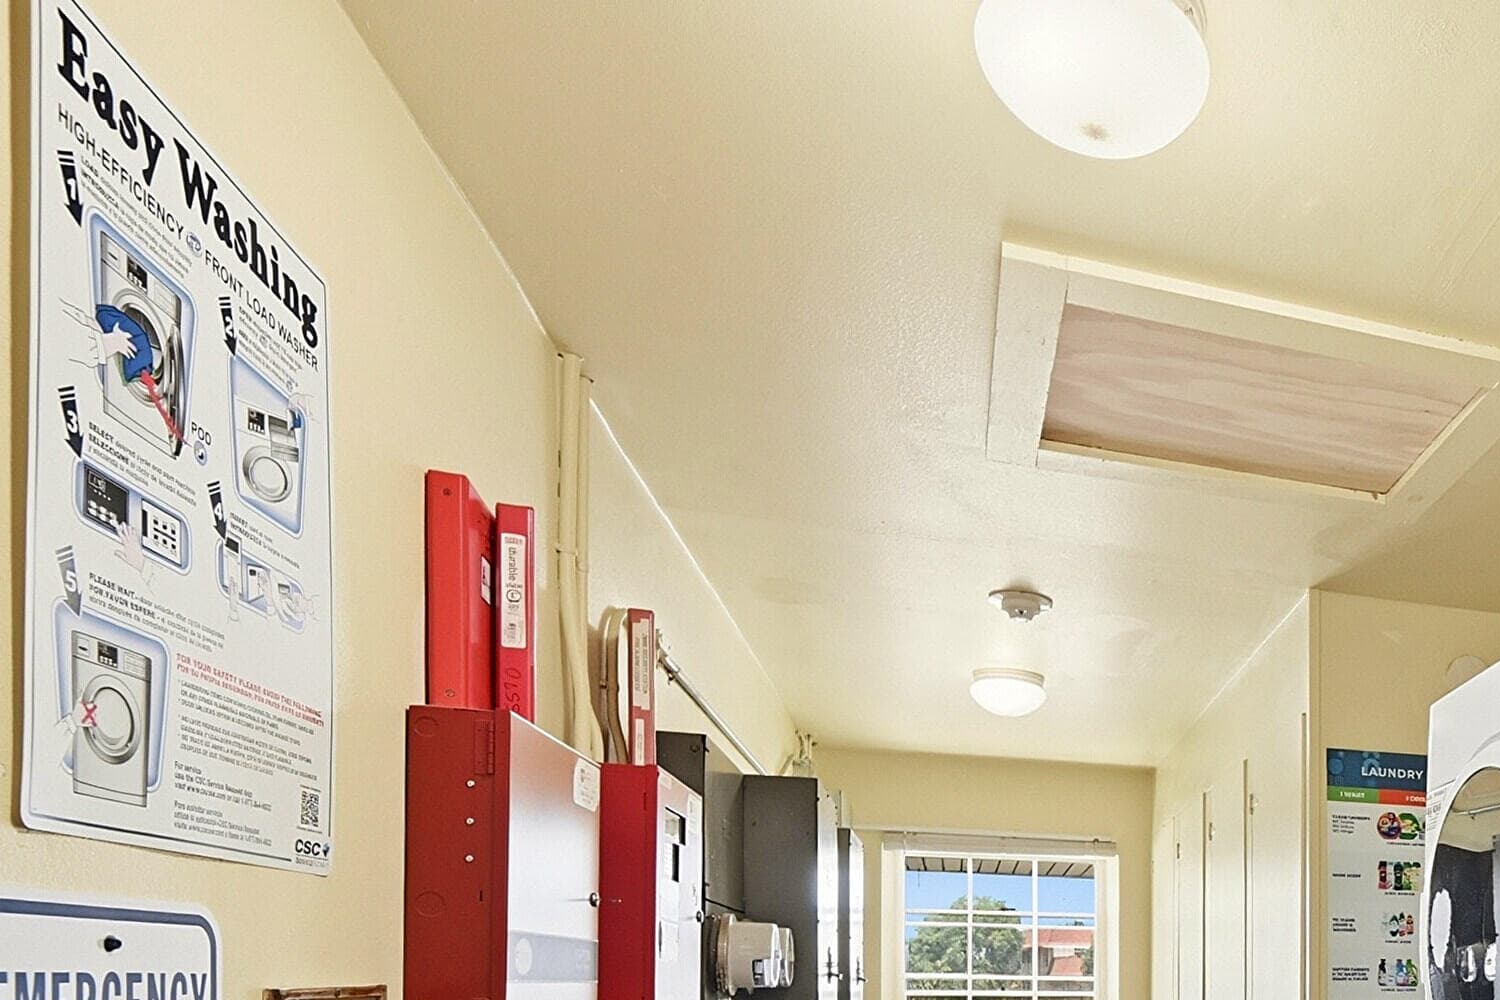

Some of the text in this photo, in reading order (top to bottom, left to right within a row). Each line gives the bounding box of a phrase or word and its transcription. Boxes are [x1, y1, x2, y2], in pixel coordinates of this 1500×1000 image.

[57, 7, 165, 186] Easy
[173, 137, 319, 349] Washing
[58, 103, 184, 240] HIGH-EFFICIENCY
[67, 178, 76, 201] 1
[205, 250, 244, 298] FRONT
[246, 290, 276, 329] LOAD
[277, 321, 319, 372] WASHER
[225, 315, 234, 337] 2
[66, 410, 78, 433] 3
[191, 421, 212, 446] POD
[214, 502, 223, 520] 4
[64, 571, 77, 593] 5
[1361, 766, 1425, 780] LAUNDRY
[295, 839, 321, 857] CSC
